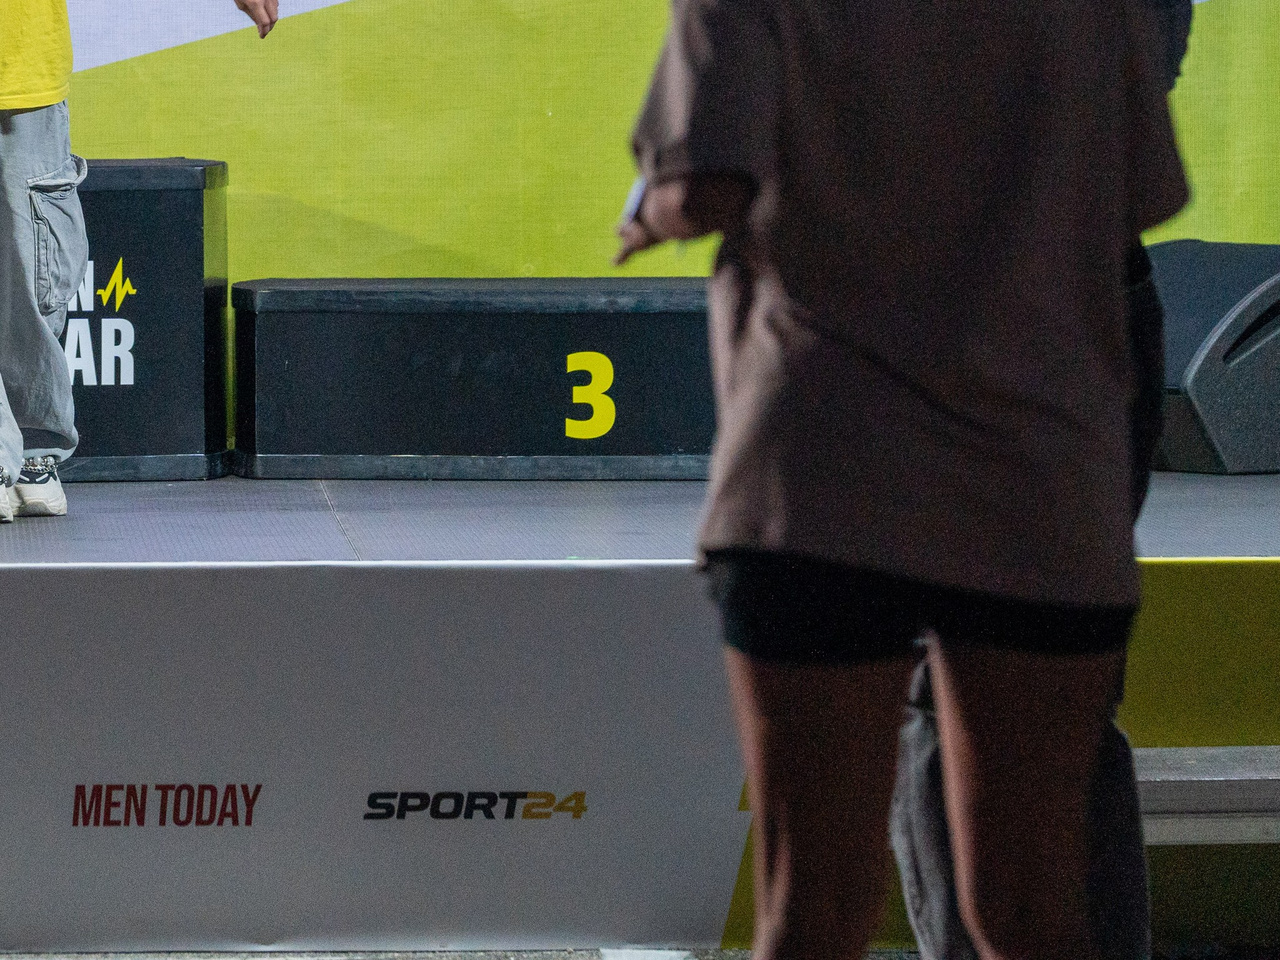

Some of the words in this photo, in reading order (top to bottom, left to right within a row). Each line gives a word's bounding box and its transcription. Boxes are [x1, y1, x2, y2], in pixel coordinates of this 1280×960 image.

[565, 351, 616, 439] 3
[72, 784, 148, 827] MEN
[155, 784, 263, 827] TODAY
[363, 791, 588, 820] SPORT24
